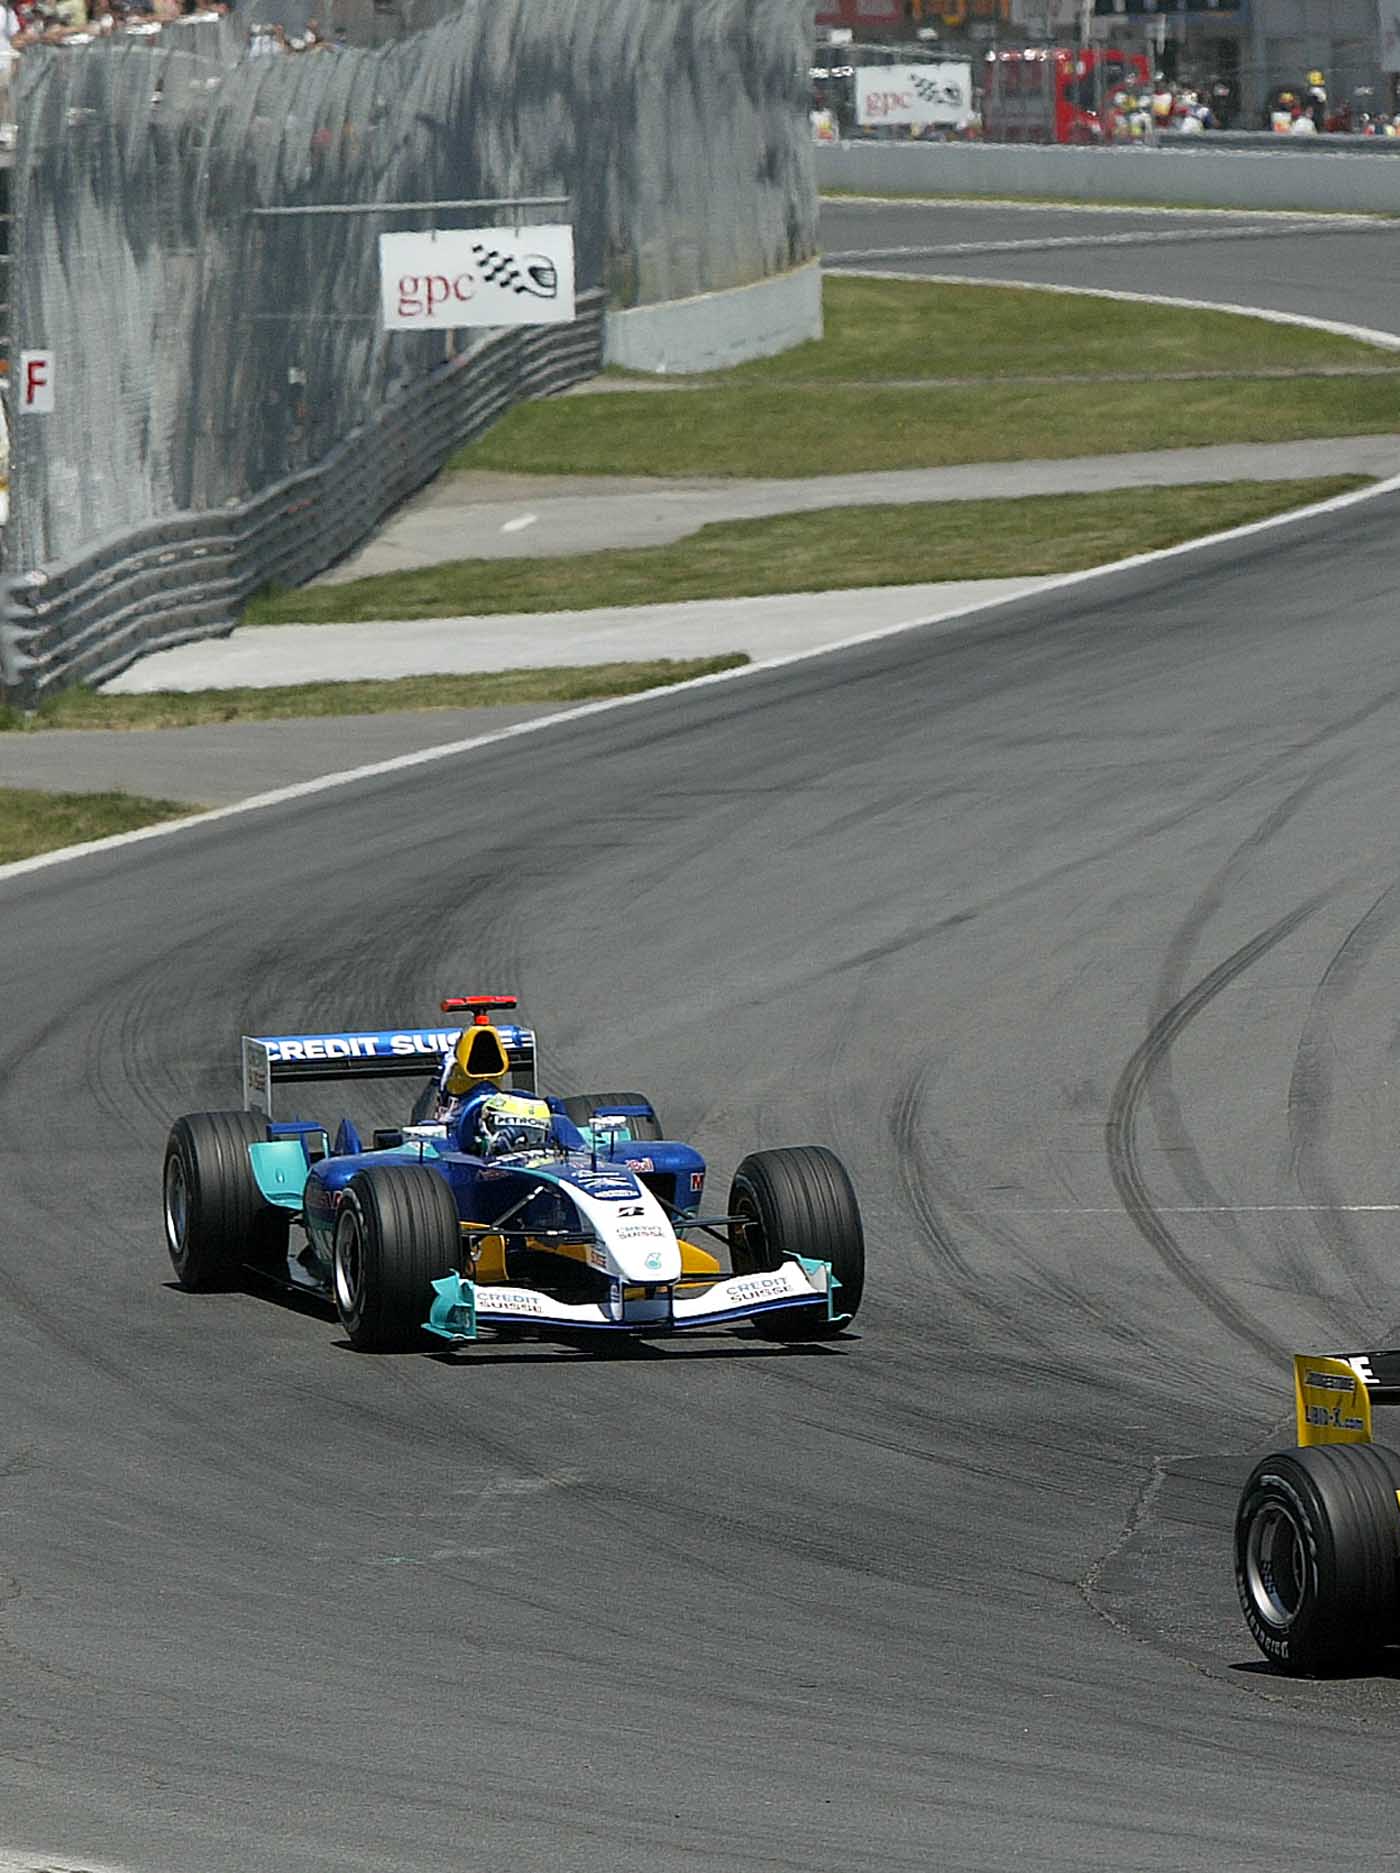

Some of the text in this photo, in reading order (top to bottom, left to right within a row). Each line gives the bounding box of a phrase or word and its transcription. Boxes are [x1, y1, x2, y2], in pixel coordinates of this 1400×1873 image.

[398, 272, 476, 317] gpc
[26, 361, 47, 405] F
[267, 1037, 380, 1061] CREDIT
[476, 1292, 541, 1304] CREDIT
[726, 1277, 787, 1295] CREDIT
